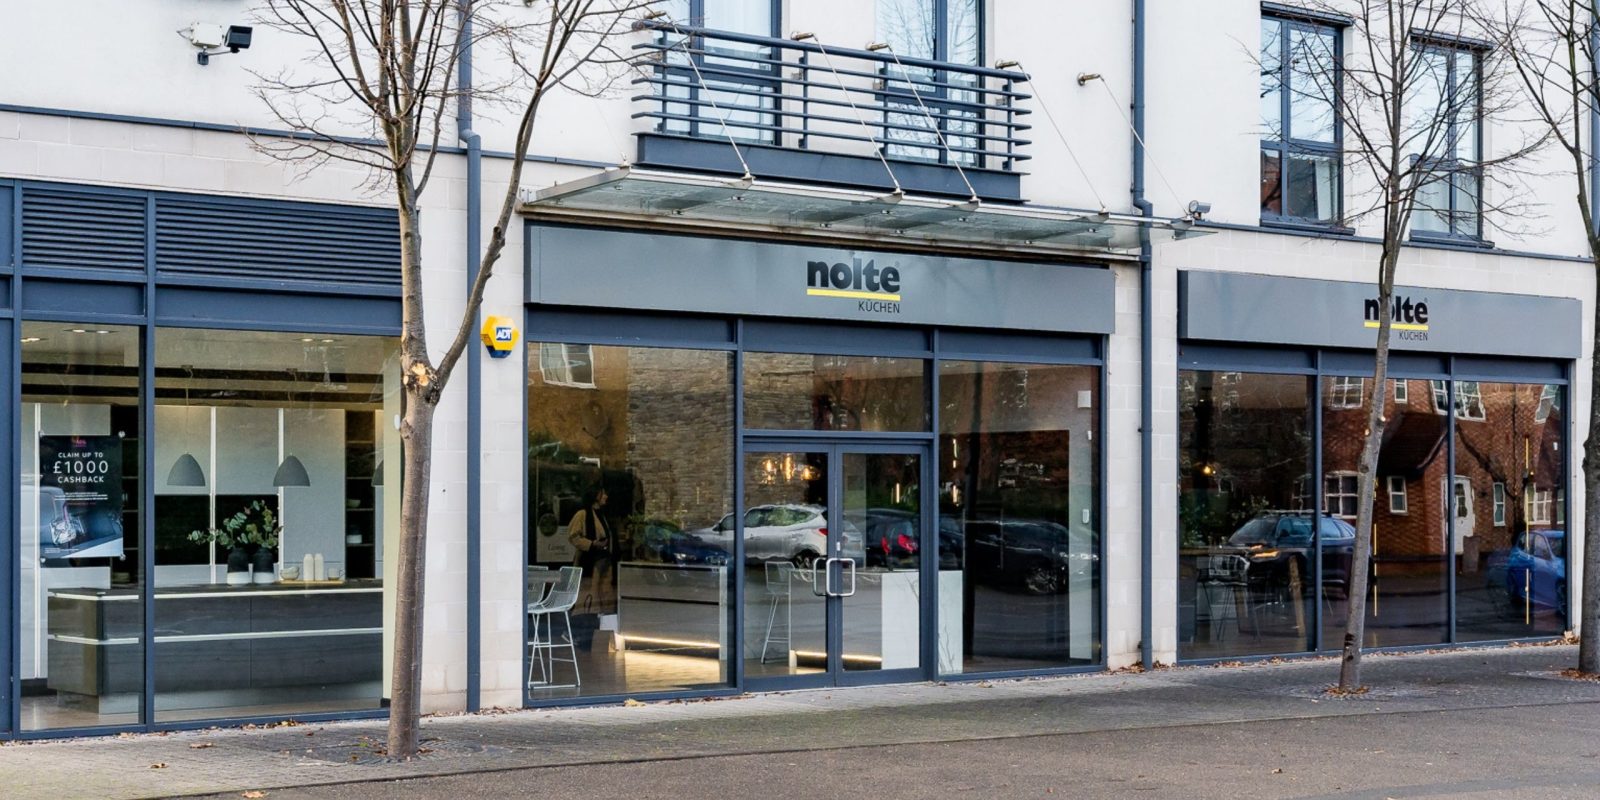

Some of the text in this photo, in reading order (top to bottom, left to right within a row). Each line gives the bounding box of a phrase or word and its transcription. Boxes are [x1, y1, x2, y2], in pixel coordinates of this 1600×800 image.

[807, 257, 900, 293] nolte
[858, 299, 900, 313] KÜCHEN
[1364, 295, 1429, 324] nlte
[496, 328, 512, 340] ADT
[1399, 329, 1428, 341] KÜCHEN
[53, 460, 109, 474] £1000
